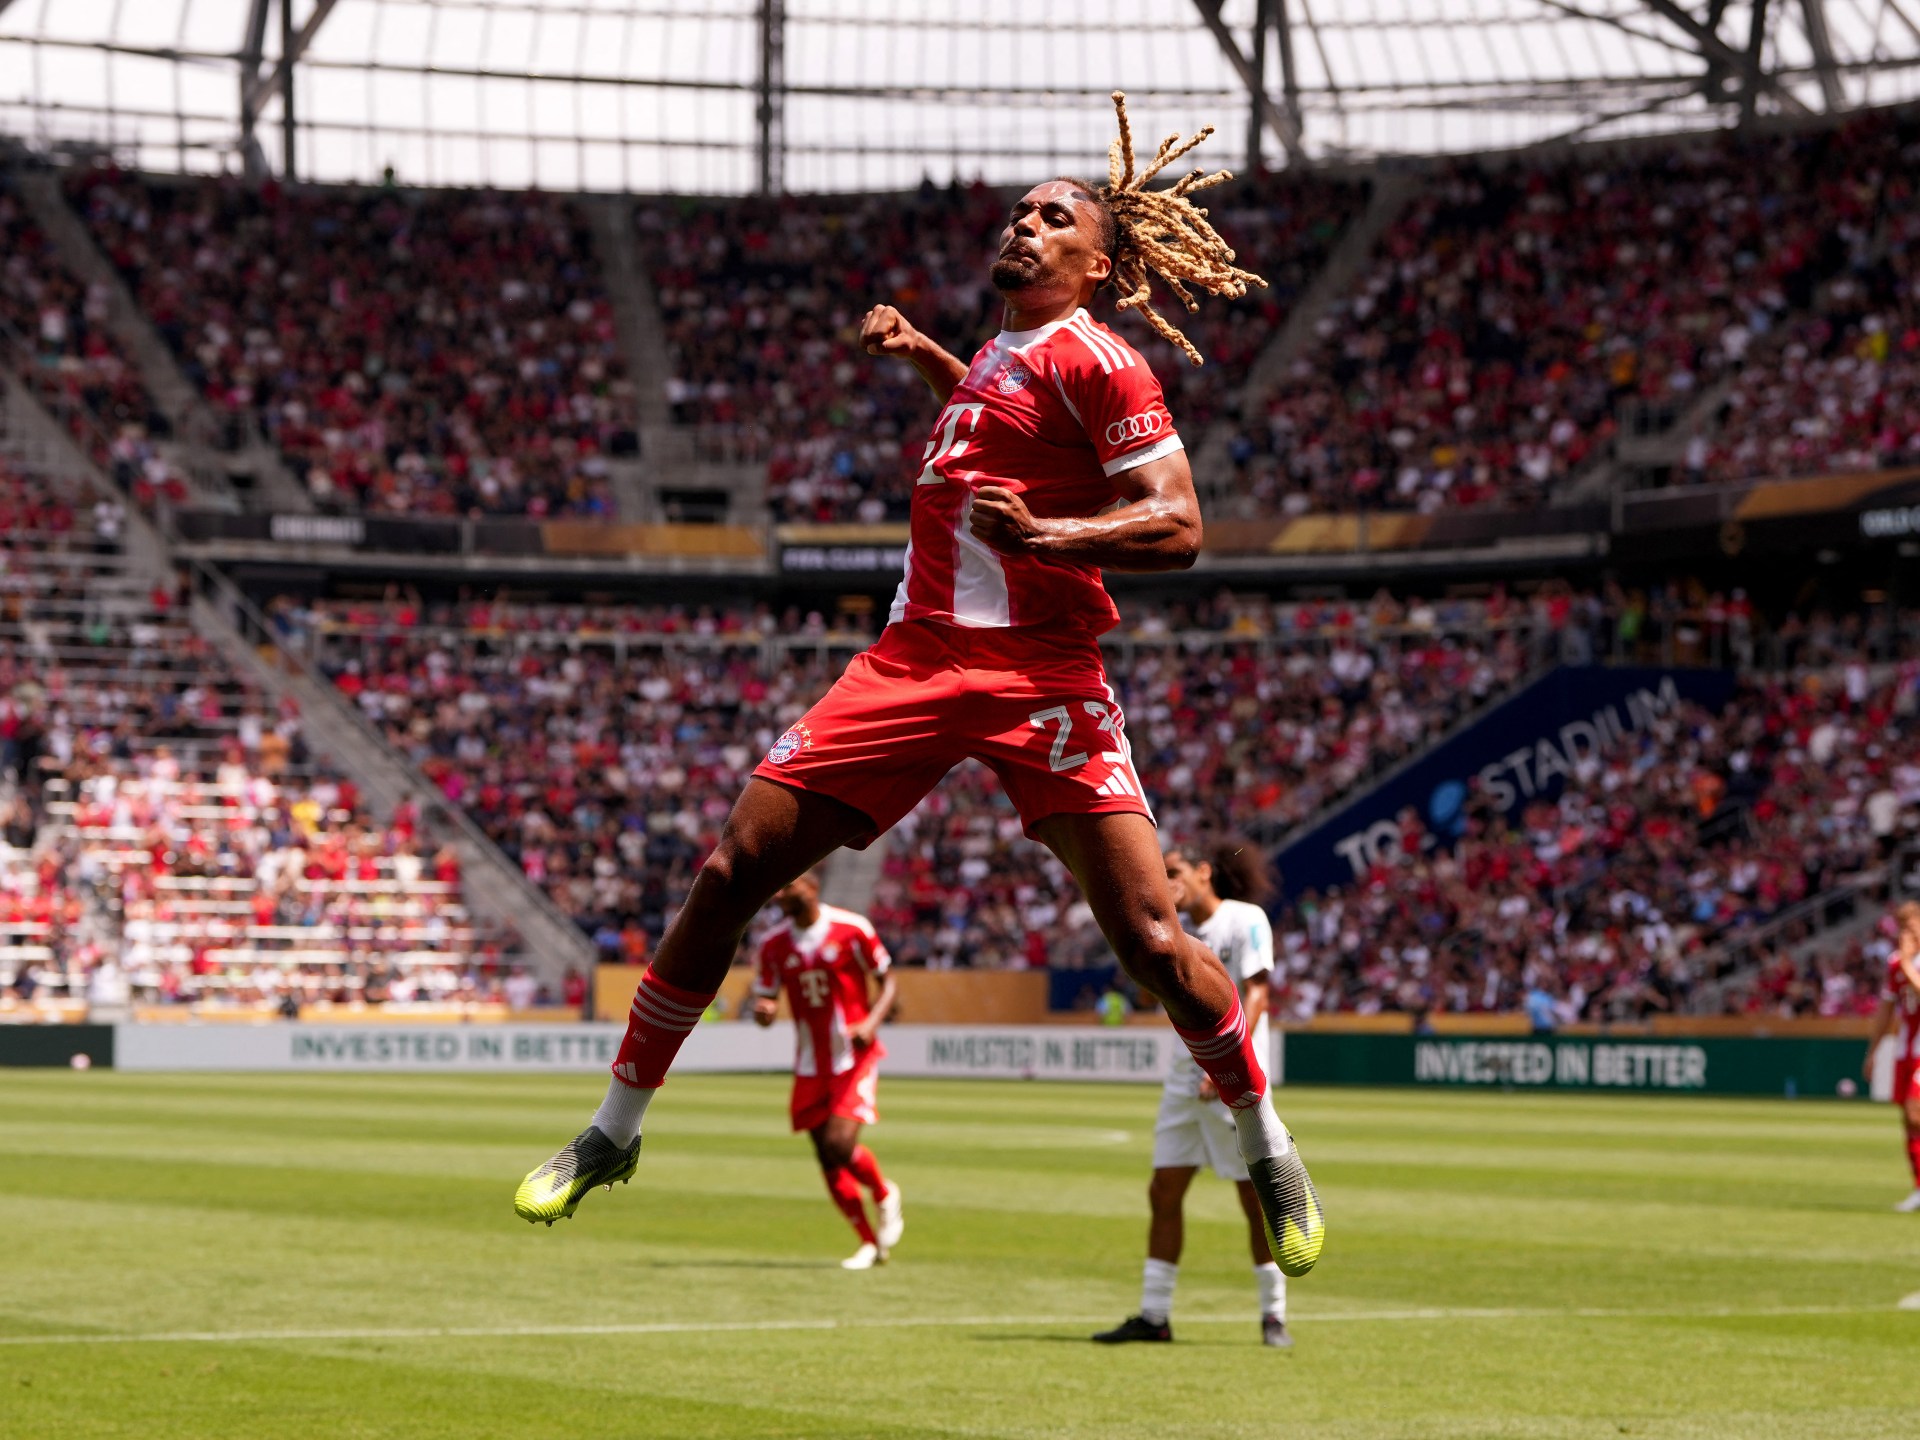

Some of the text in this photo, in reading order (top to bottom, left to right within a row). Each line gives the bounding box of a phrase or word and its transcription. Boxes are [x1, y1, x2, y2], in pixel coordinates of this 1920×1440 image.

[917, 402, 986, 485] T
[1029, 701, 1126, 772] 23
[1479, 676, 1680, 811] STADIUM
[800, 969, 829, 1007] T
[291, 1032, 460, 1063] INVESTED
[467, 1032, 504, 1063] IN
[927, 1035, 1160, 1070] INVESTED IN BETTER
[1414, 1042, 1707, 1086] INVESTED IN BETTER
